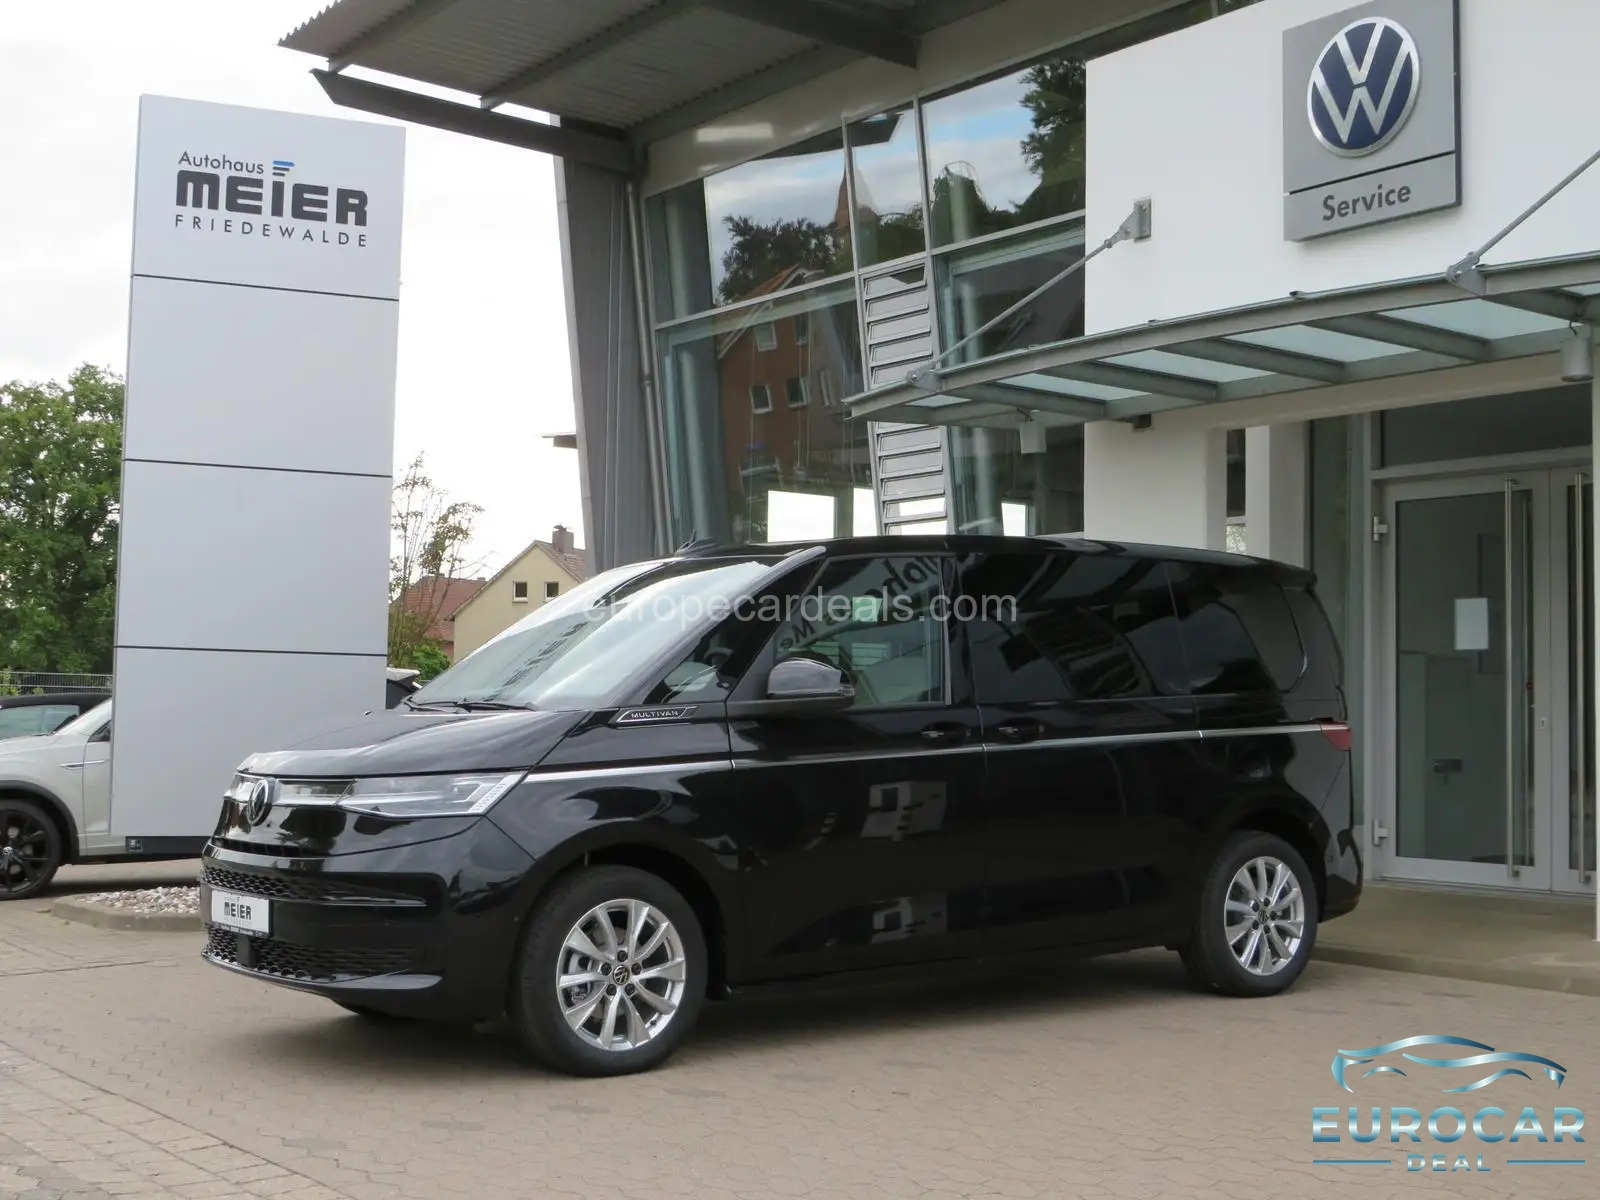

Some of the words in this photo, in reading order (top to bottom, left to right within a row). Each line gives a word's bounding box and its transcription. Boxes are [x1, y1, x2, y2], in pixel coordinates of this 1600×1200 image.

[178, 150, 264, 175] Autohaus
[176, 168, 368, 227] MEIER
[1322, 184, 1411, 221] Service
[175, 214, 367, 247] FRIEDEWALDE
[631, 710, 678, 718] MULTIVAN
[224, 901, 252, 920] MEIER
